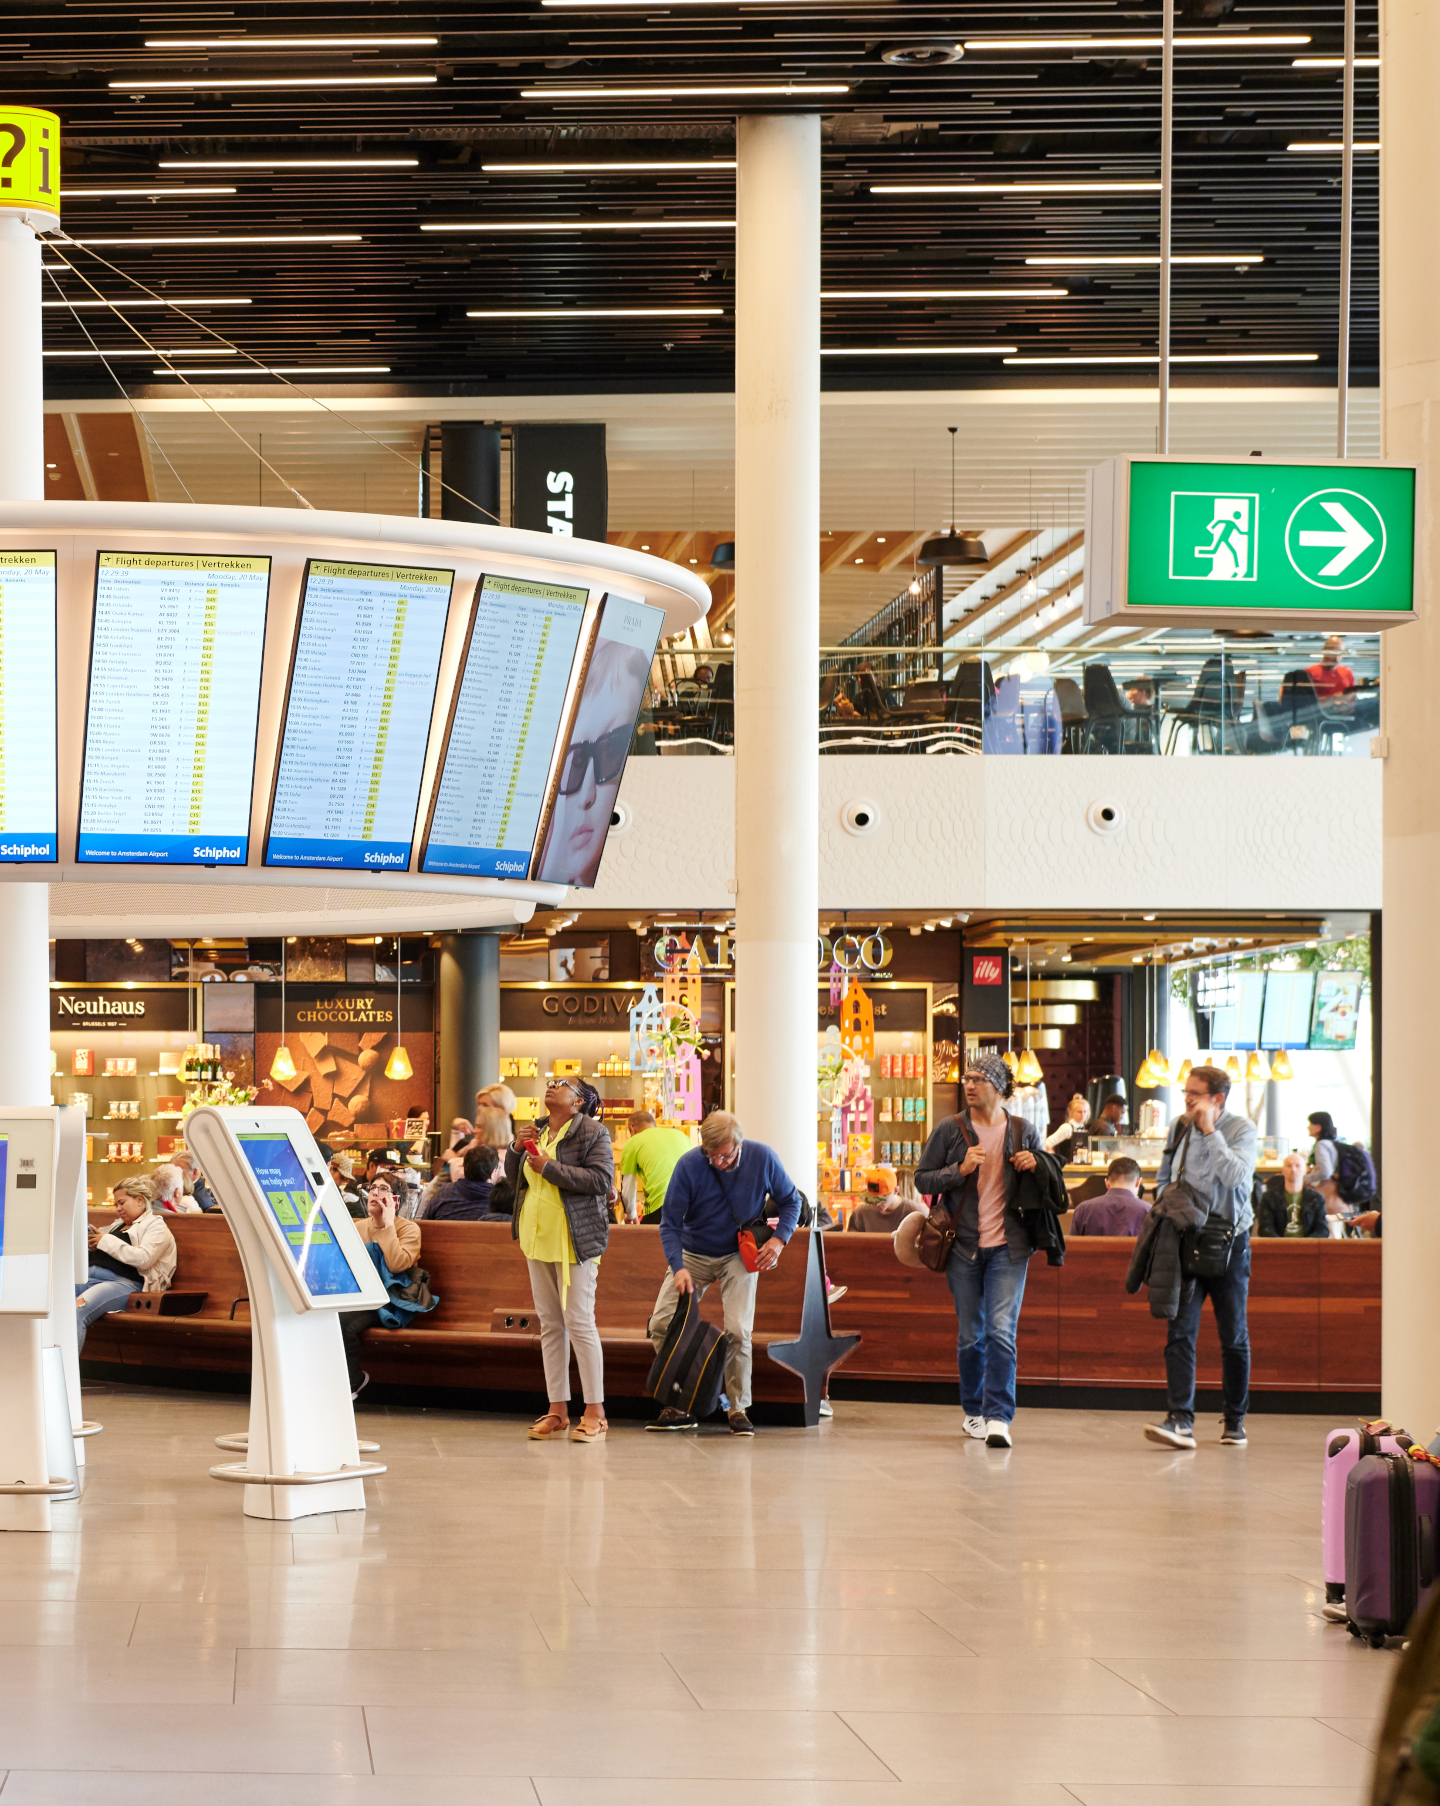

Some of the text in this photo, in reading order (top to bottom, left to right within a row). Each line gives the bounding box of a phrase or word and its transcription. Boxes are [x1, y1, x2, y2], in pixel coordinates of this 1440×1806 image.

[39, 128, 52, 194] i
[547, 471, 574, 537] STA
[116, 557, 251, 569] Flight departures Vertrekken
[324, 566, 437, 581] Flight departures Vertrekken
[494, 581, 576, 599] Flight departures Vertrekken
[624, 615, 642, 628] PRADA
[1, 844, 49, 857] Schiphol
[193, 847, 240, 860] Schiphol
[364, 852, 404, 865] Schiphol
[495, 861, 525, 873] Schiphol
[974, 960, 1000, 983] illy
[58, 996, 145, 1014] Neuhaus
[316, 999, 374, 1010] LUXURY
[543, 995, 638, 1013] GODIVA
[297, 1010, 393, 1023] CHOCOLATES
[569, 1016, 596, 1024] Belgium
[270, 1168, 281, 1176] may
[270, 1177, 282, 1186] help
